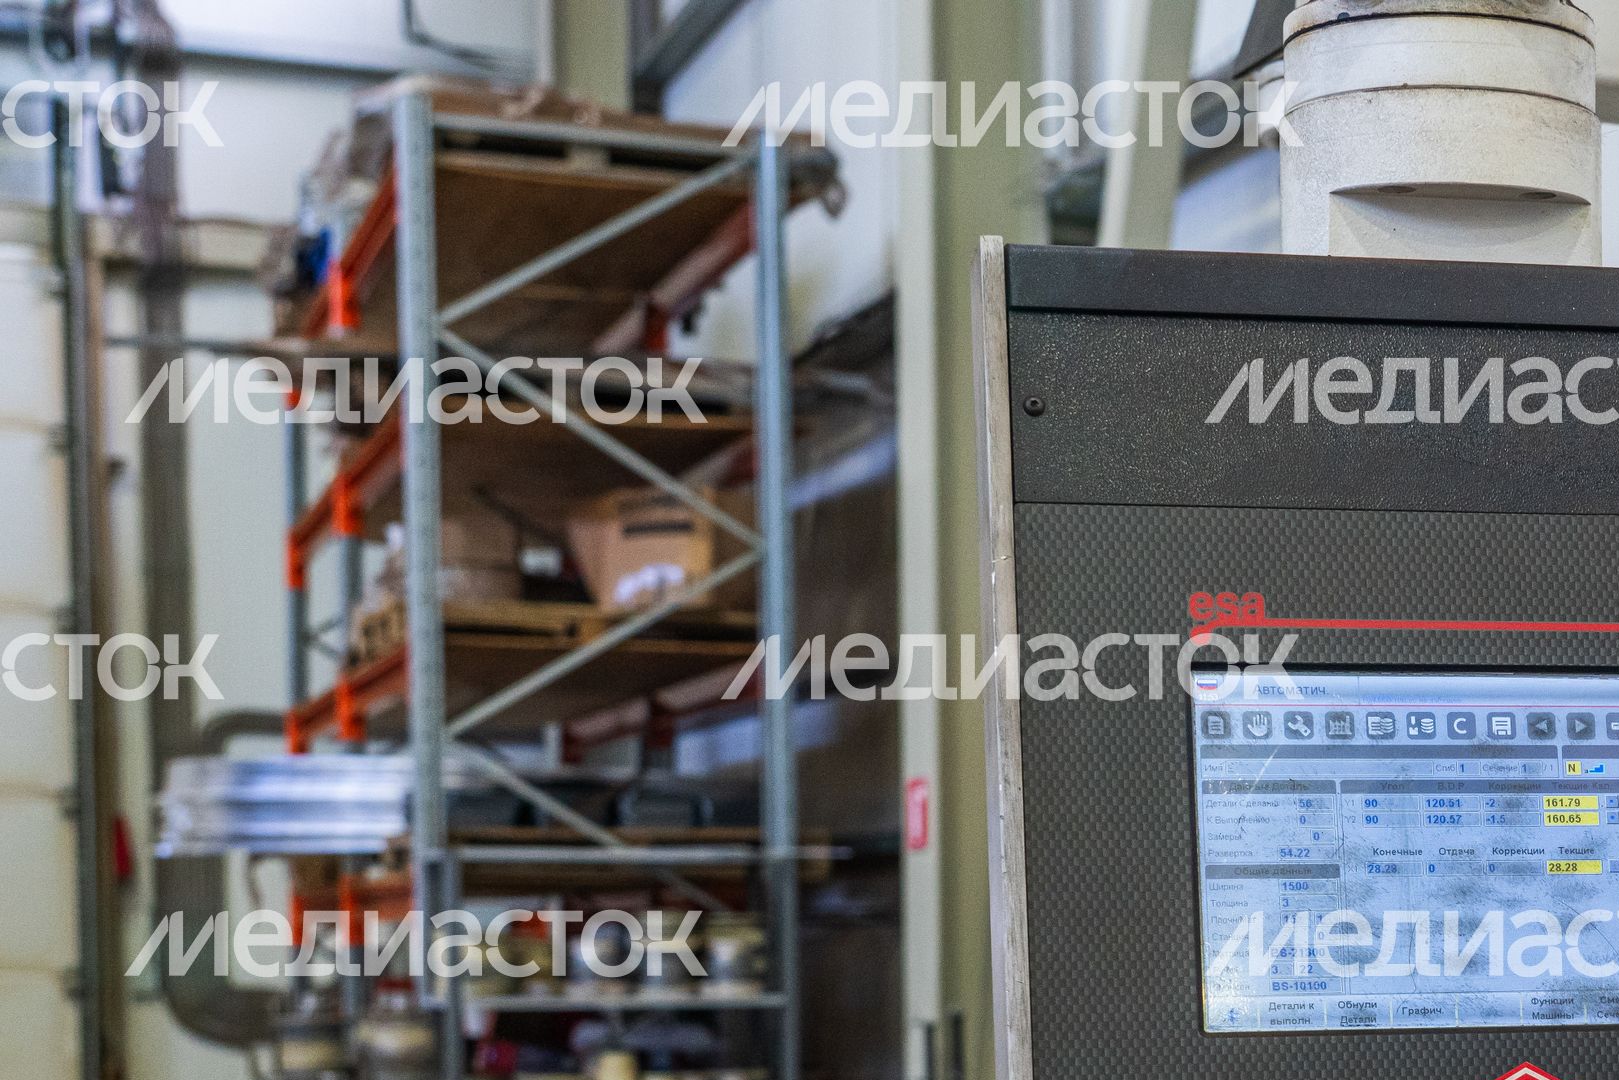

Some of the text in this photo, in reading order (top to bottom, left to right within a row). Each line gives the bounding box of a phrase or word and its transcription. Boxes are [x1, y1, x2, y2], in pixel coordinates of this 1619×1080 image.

[1188, 591, 1265, 626] esa
[1254, 684, 1329, 696] Автоматич.
[1568, 763, 1576, 772] N
[1488, 782, 1541, 793] Коррекции
[1364, 799, 1378, 808] 90
[1425, 799, 1462, 808] 120.51
[1545, 798, 1581, 807] 161.79
[1365, 815, 1379, 824] 90
[1426, 815, 1462, 824] 120.57
[1486, 815, 1506, 824] -1.5
[1546, 815, 1582, 824] 160.65
[1280, 849, 1311, 858] 54.22
[1373, 848, 1423, 856] Конечные
[1439, 848, 1476, 857] Отдача
[1492, 847, 1545, 857] Коррекции
[1367, 864, 1398, 874] 28.28
[1548, 863, 1578, 872] 28.28
[1208, 882, 1244, 891] Ширина
[1282, 882, 1309, 890] 1500
[1210, 900, 1249, 909] Толщина
[1272, 982, 1328, 992] BS-10100
[1269, 1002, 1306, 1012] Детали
[1338, 1001, 1378, 1010] Обнули
[1401, 1006, 1445, 1016] Графич.
[1340, 1016, 1377, 1025] Детали
[1532, 1012, 1575, 1020] Машины
